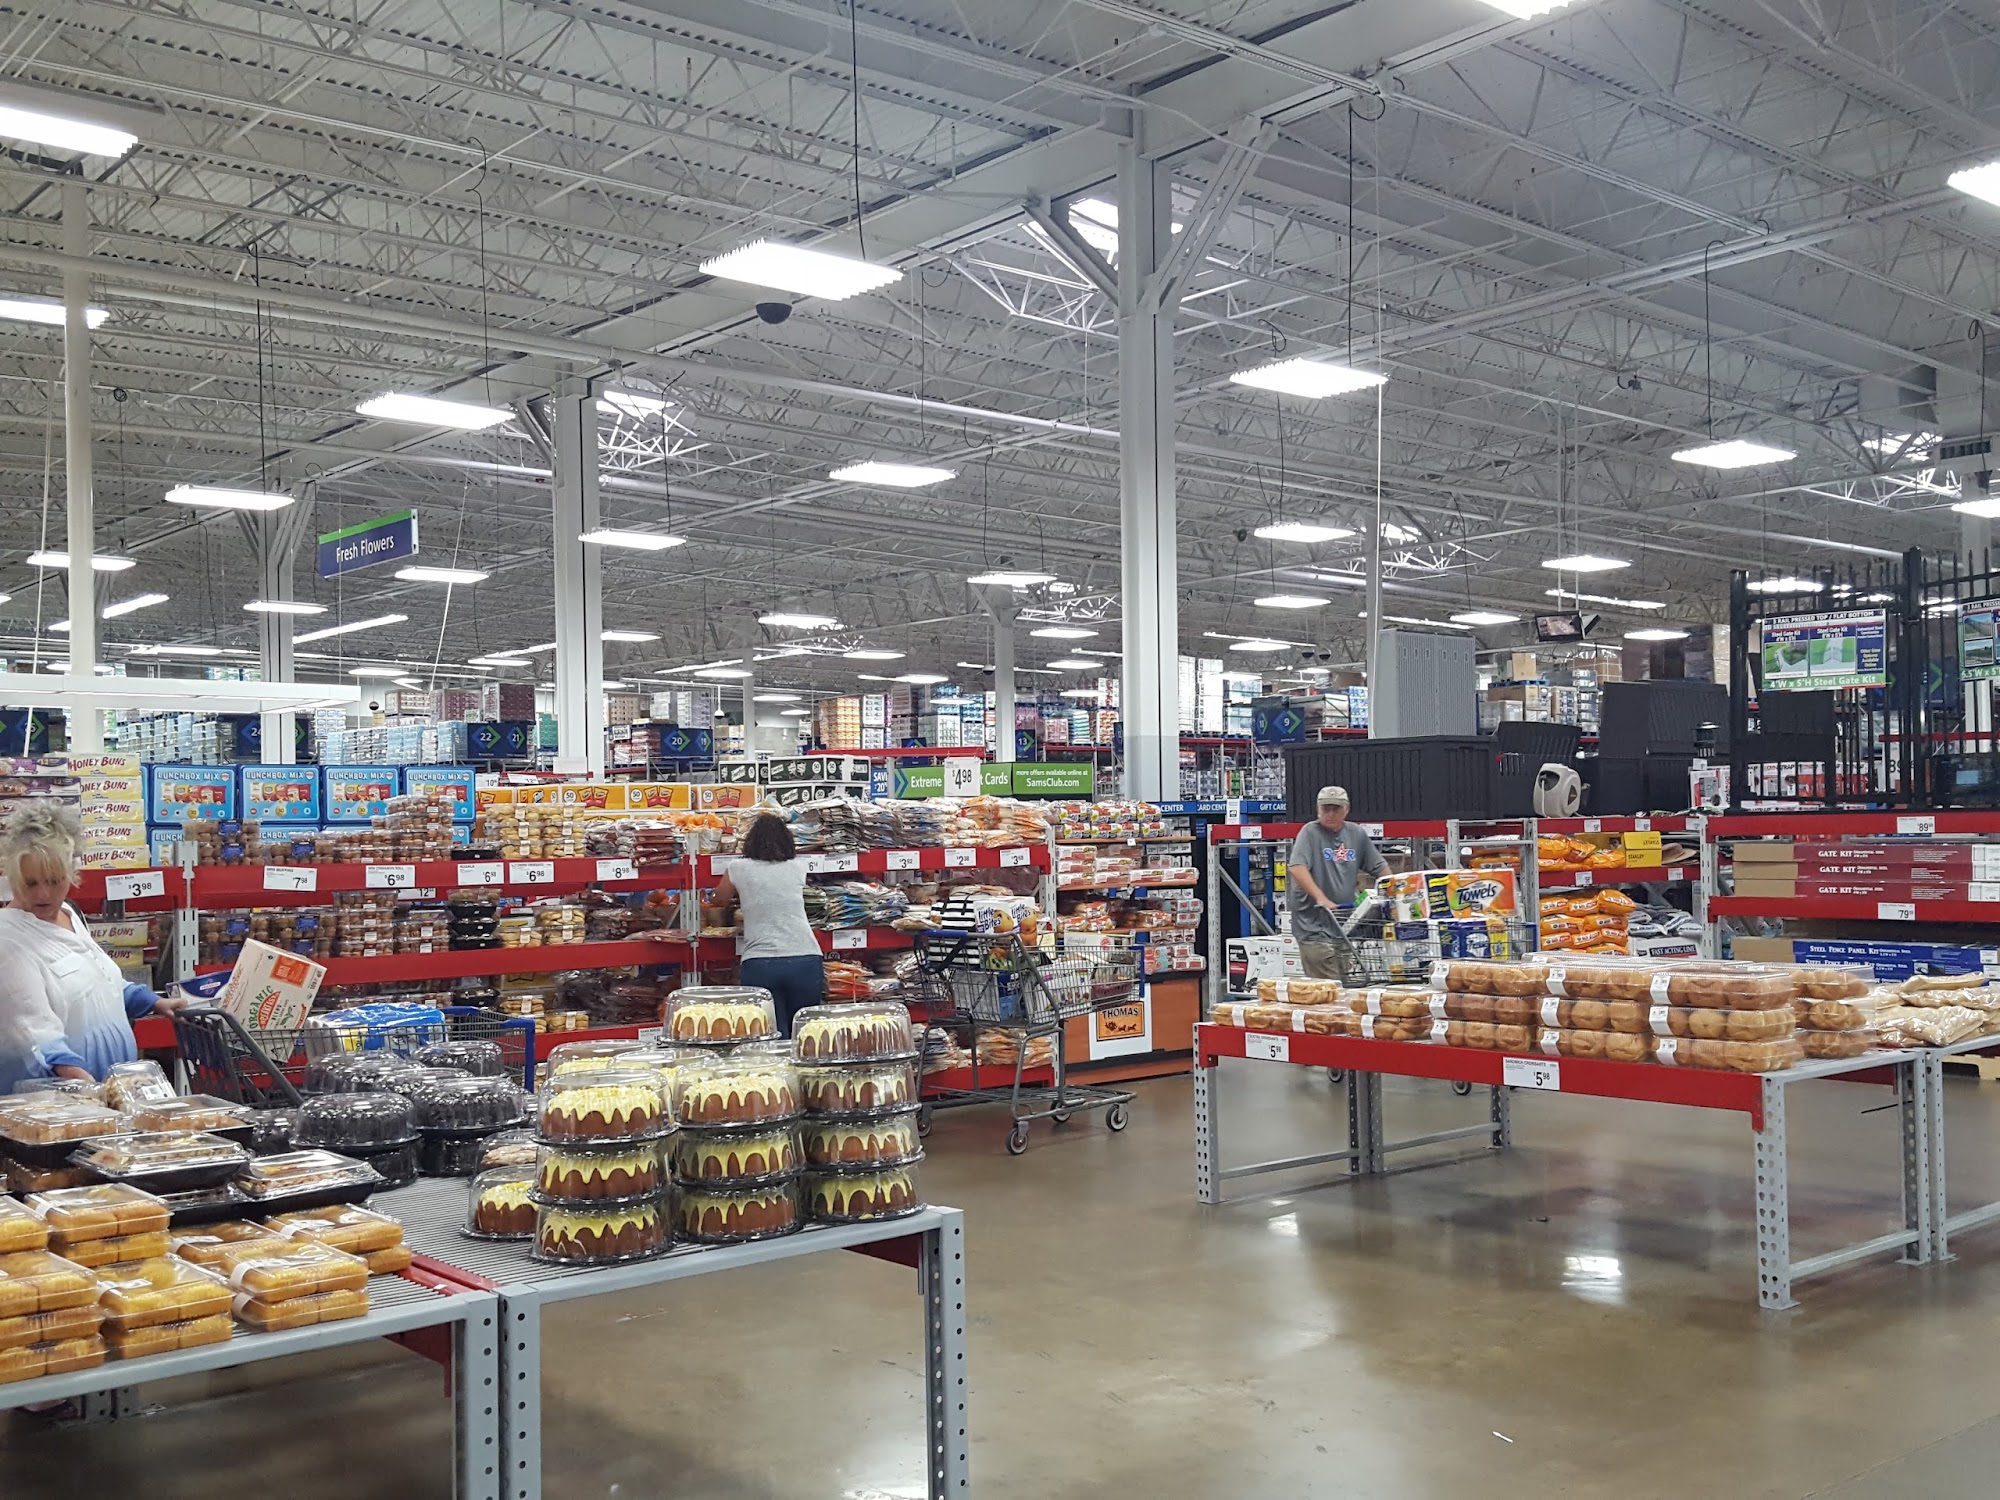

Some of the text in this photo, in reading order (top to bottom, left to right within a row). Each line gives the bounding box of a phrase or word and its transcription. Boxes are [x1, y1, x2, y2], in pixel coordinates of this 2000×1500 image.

[336, 536, 394, 563] Fresh Flowers
[1791, 615, 1815, 623] PRESSED
[1849, 610, 1874, 618] BOTTOM
[1814, 678, 1836, 686] Steel
[1839, 676, 1859, 684] Gate
[1862, 676, 1876, 684] Kit
[1284, 718, 1290, 726] 9
[480, 733, 492, 741] 22
[512, 733, 520, 741] 21
[672, 737, 682, 745] 20
[68, 757, 99, 772] HONEY
[101, 757, 126, 767] BUNS
[158, 771, 219, 780] LUNCHBOX MIX
[246, 771, 304, 780] LUNCHBOX MIX
[329, 772, 367, 780] LUNCHBOX
[409, 772, 446, 781] LUNCHBOX
[911, 776, 942, 788] Extreme
[985, 772, 1009, 785] Cards
[80, 780, 128, 793] ONEY BUNS
[1026, 778, 1079, 788] SamsClub.com
[106, 803, 130, 813] BUNS
[1160, 804, 1184, 812] CENTER
[107, 827, 131, 837] BUNS
[111, 849, 136, 861] BUNS
[1818, 850, 1837, 858] GATE
[1457, 883, 1498, 905] Towels
[1017, 909, 1030, 922] Bites
[984, 918, 1001, 931] Bites
[109, 926, 135, 937] BUNS
[1664, 947, 1680, 955] ACTING
[248, 985, 274, 1029] ORGANIC
[1102, 1007, 1139, 1019] THOMAS
